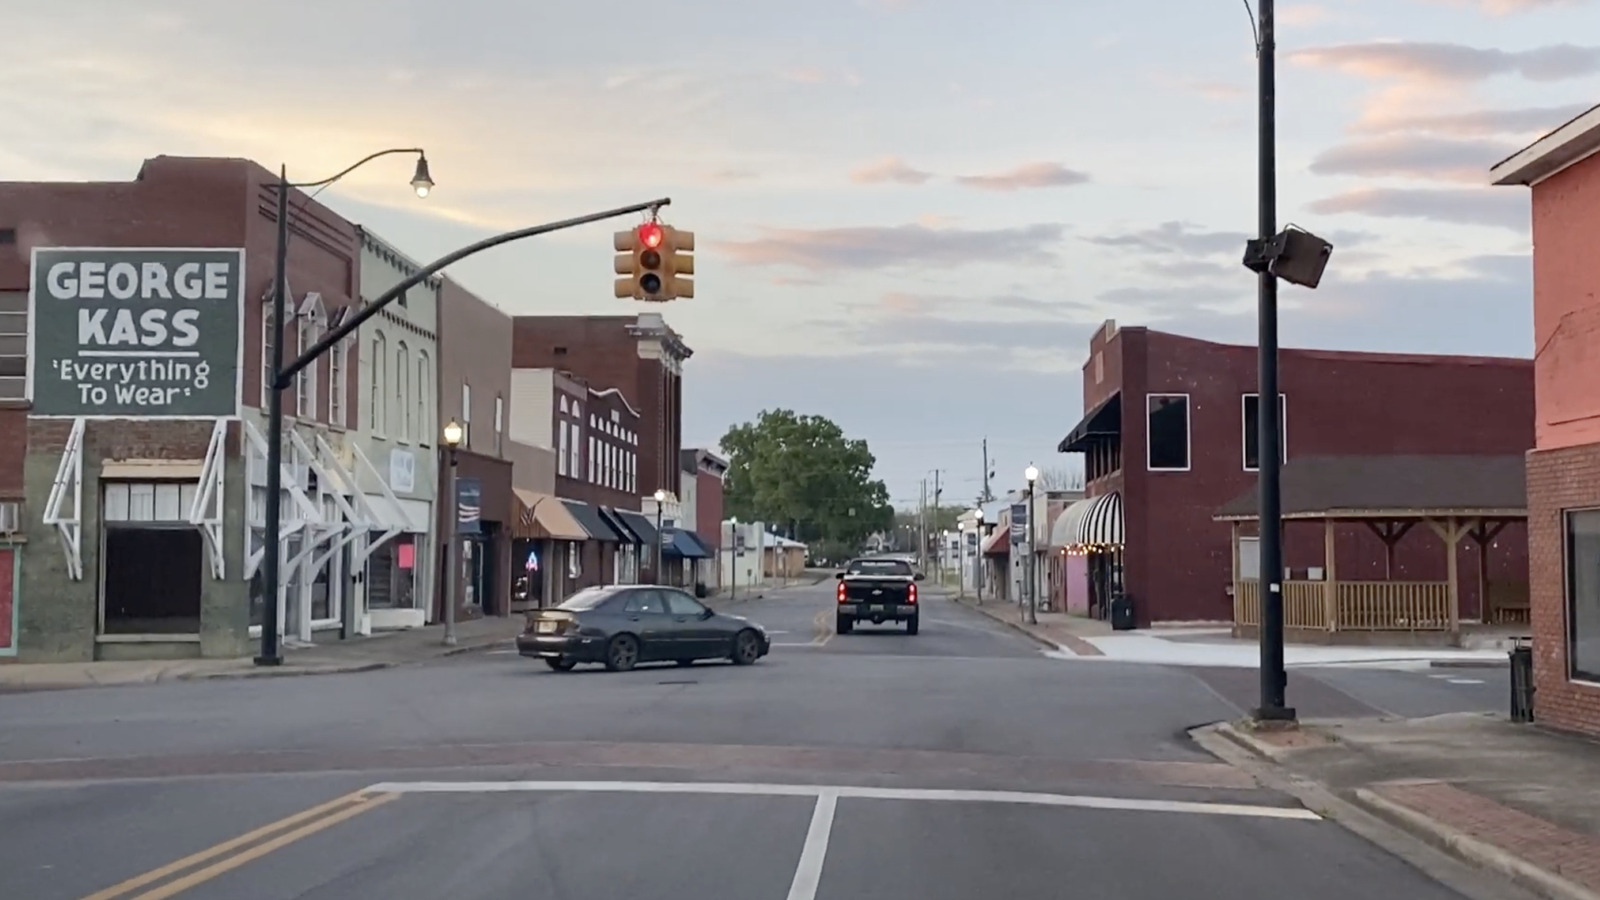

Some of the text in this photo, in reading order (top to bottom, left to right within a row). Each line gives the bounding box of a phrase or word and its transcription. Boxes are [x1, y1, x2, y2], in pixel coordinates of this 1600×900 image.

[47, 262, 230, 299] GEORGE
[78, 308, 200, 347] KASS
[77, 383, 107, 405] To
